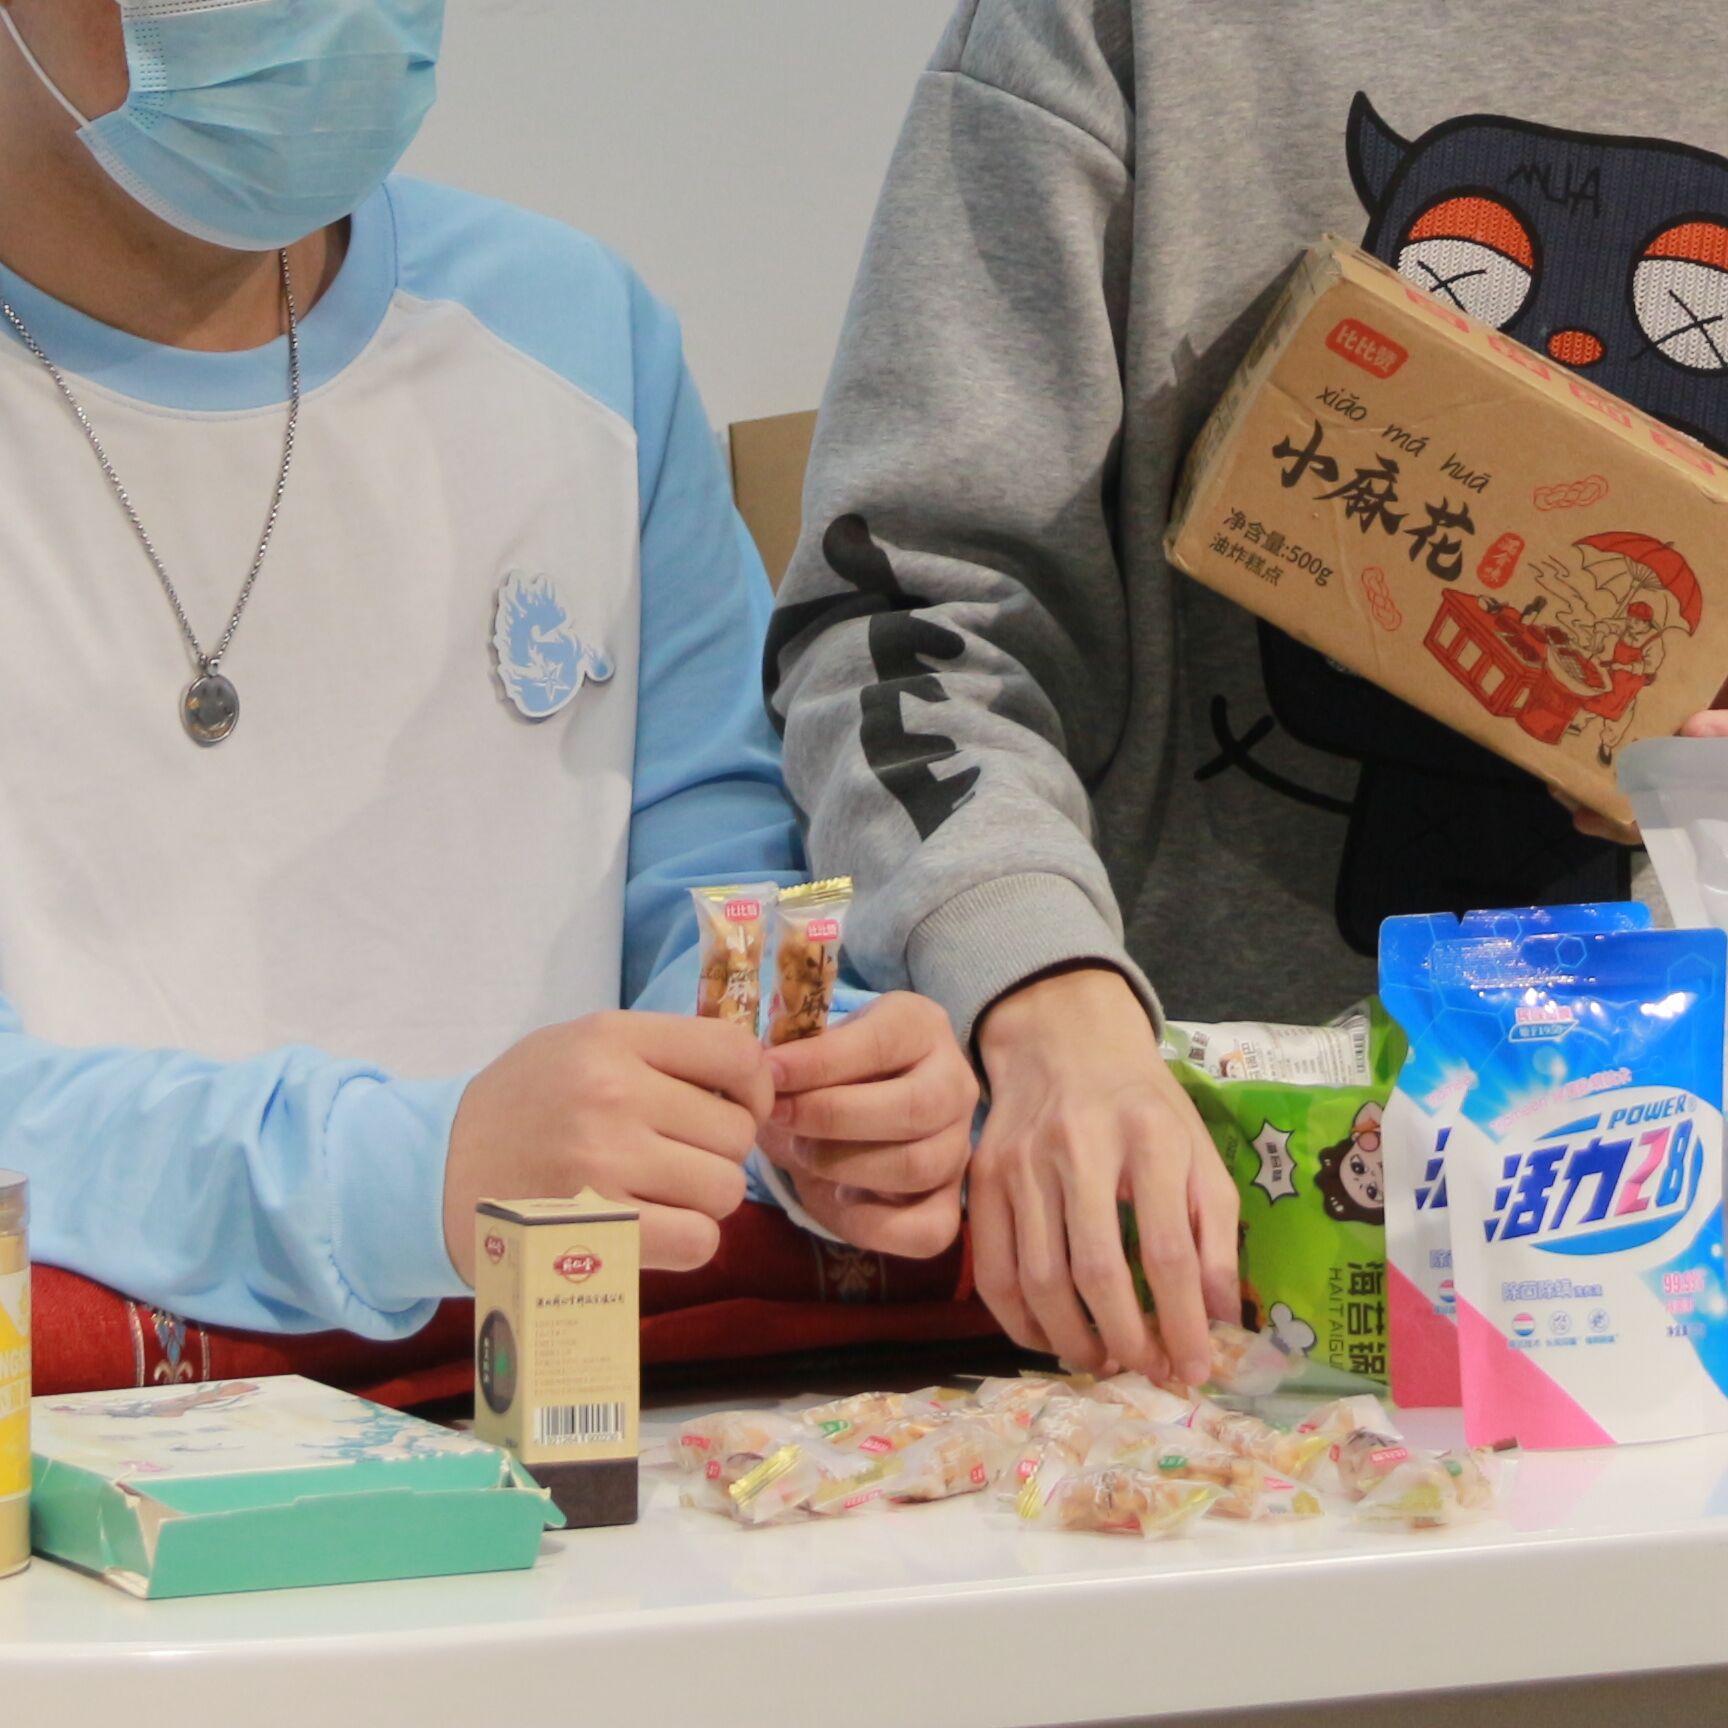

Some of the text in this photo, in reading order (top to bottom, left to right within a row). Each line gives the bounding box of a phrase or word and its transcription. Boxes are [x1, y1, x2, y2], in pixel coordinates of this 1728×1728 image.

[1272, 419, 1477, 583] 小麻花
[1606, 1093, 1687, 1131] POWER
[1484, 1118, 1697, 1244] 活力28
[1346, 1260, 1387, 1384] 海苔锅
